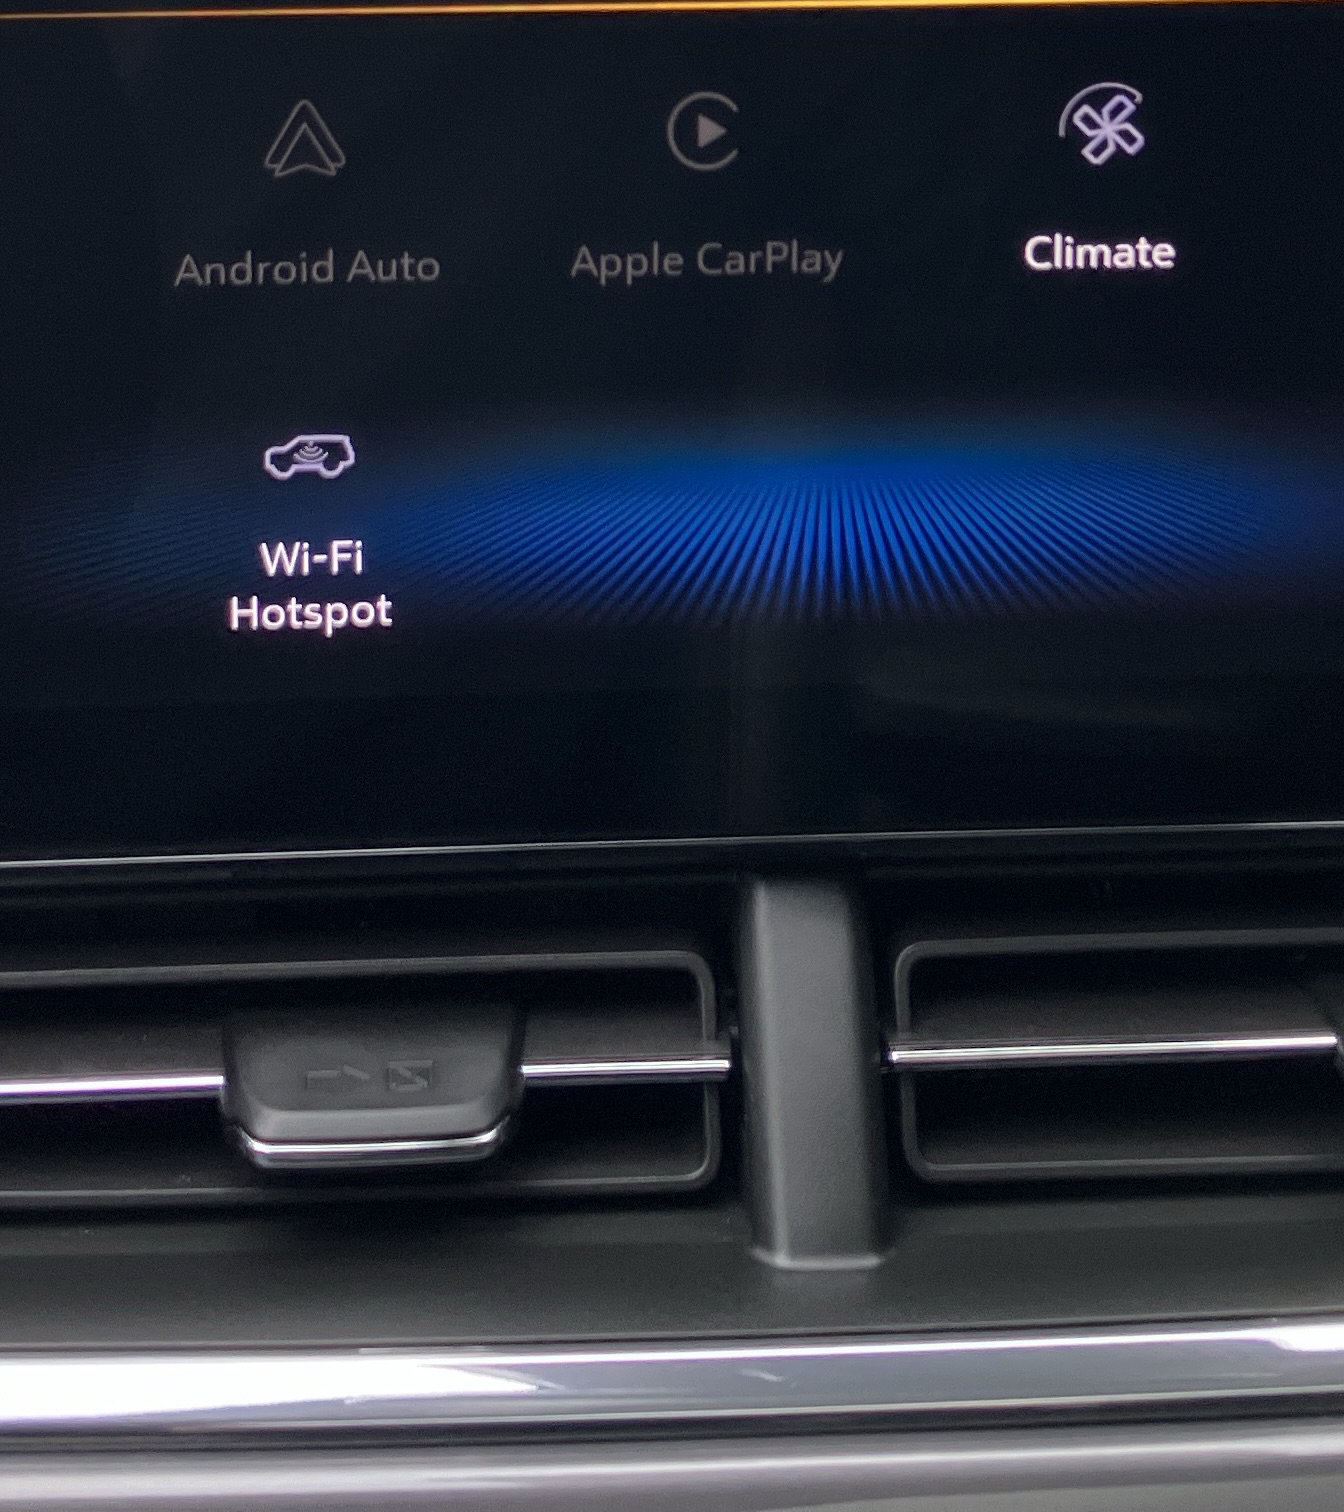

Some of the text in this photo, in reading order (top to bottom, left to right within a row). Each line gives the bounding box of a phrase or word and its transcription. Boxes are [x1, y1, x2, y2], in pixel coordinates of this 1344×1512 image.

[173, 248, 441, 287] Android Auto
[569, 238, 844, 287] Apple CarPlay
[1023, 232, 1177, 272] Climate
[259, 539, 363, 577] Wi-Fi
[229, 594, 394, 638] Hotspot
